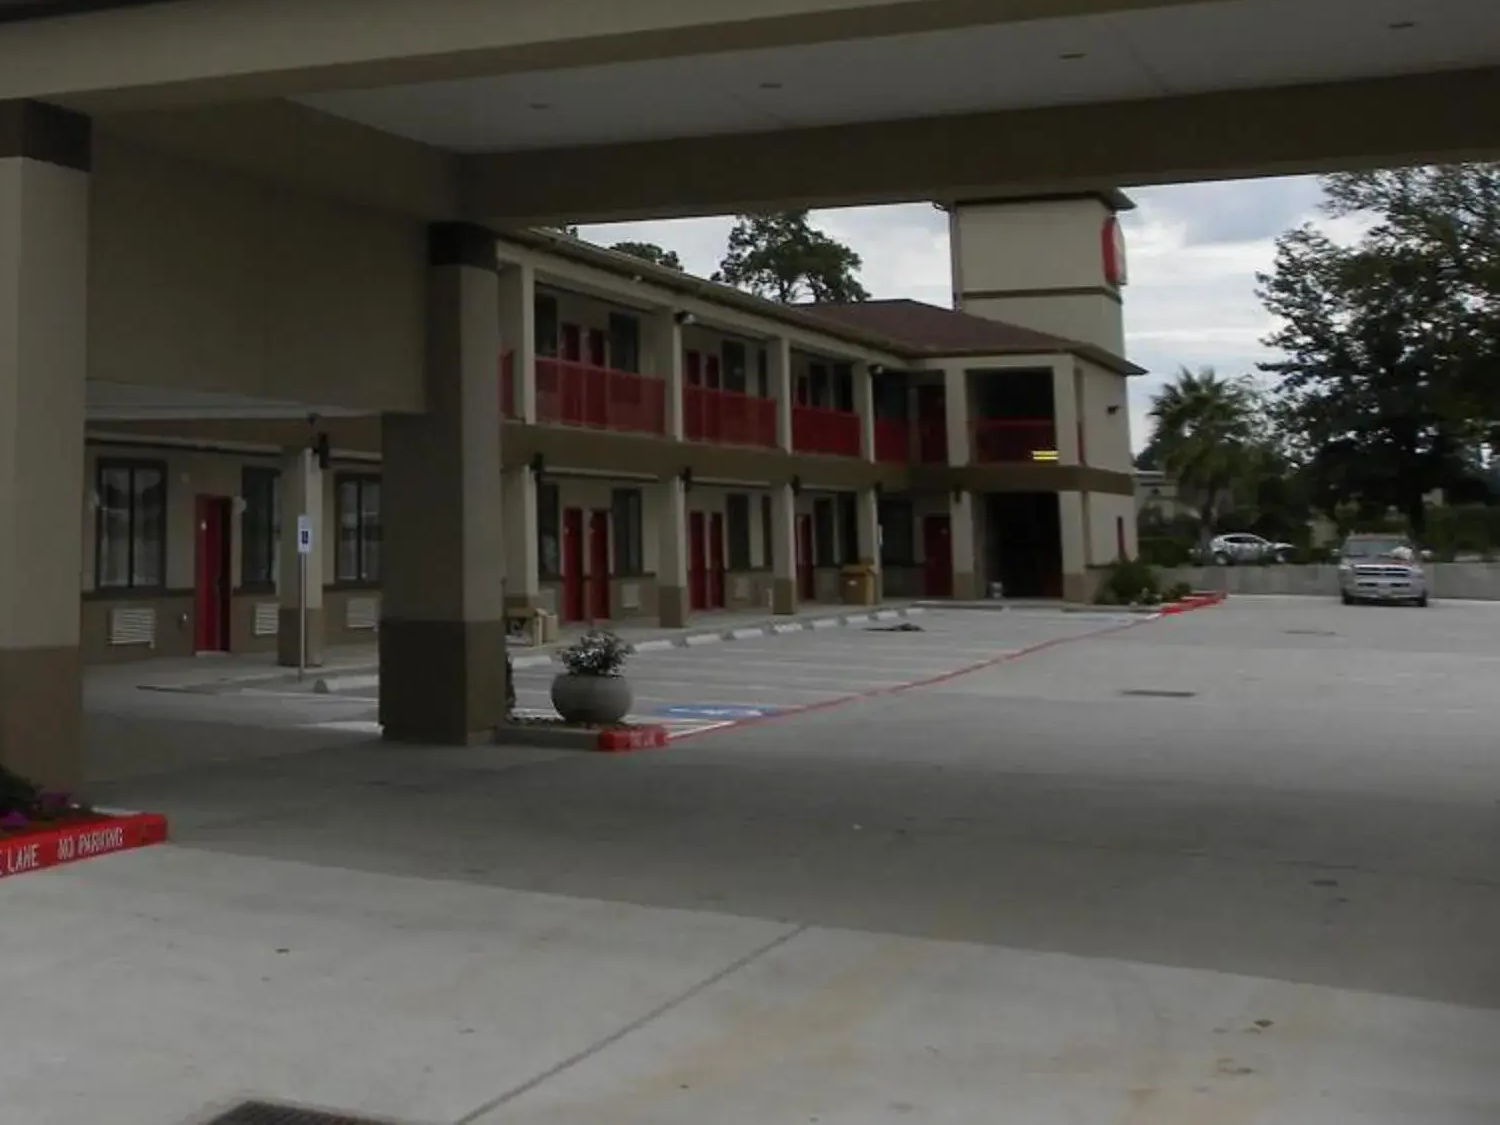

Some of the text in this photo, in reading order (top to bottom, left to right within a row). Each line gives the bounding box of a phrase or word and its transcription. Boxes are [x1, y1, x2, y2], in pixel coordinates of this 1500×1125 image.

[7, 843, 41, 874] LANE
[56, 836, 76, 860] NO
[77, 826, 124, 855] PARKING
